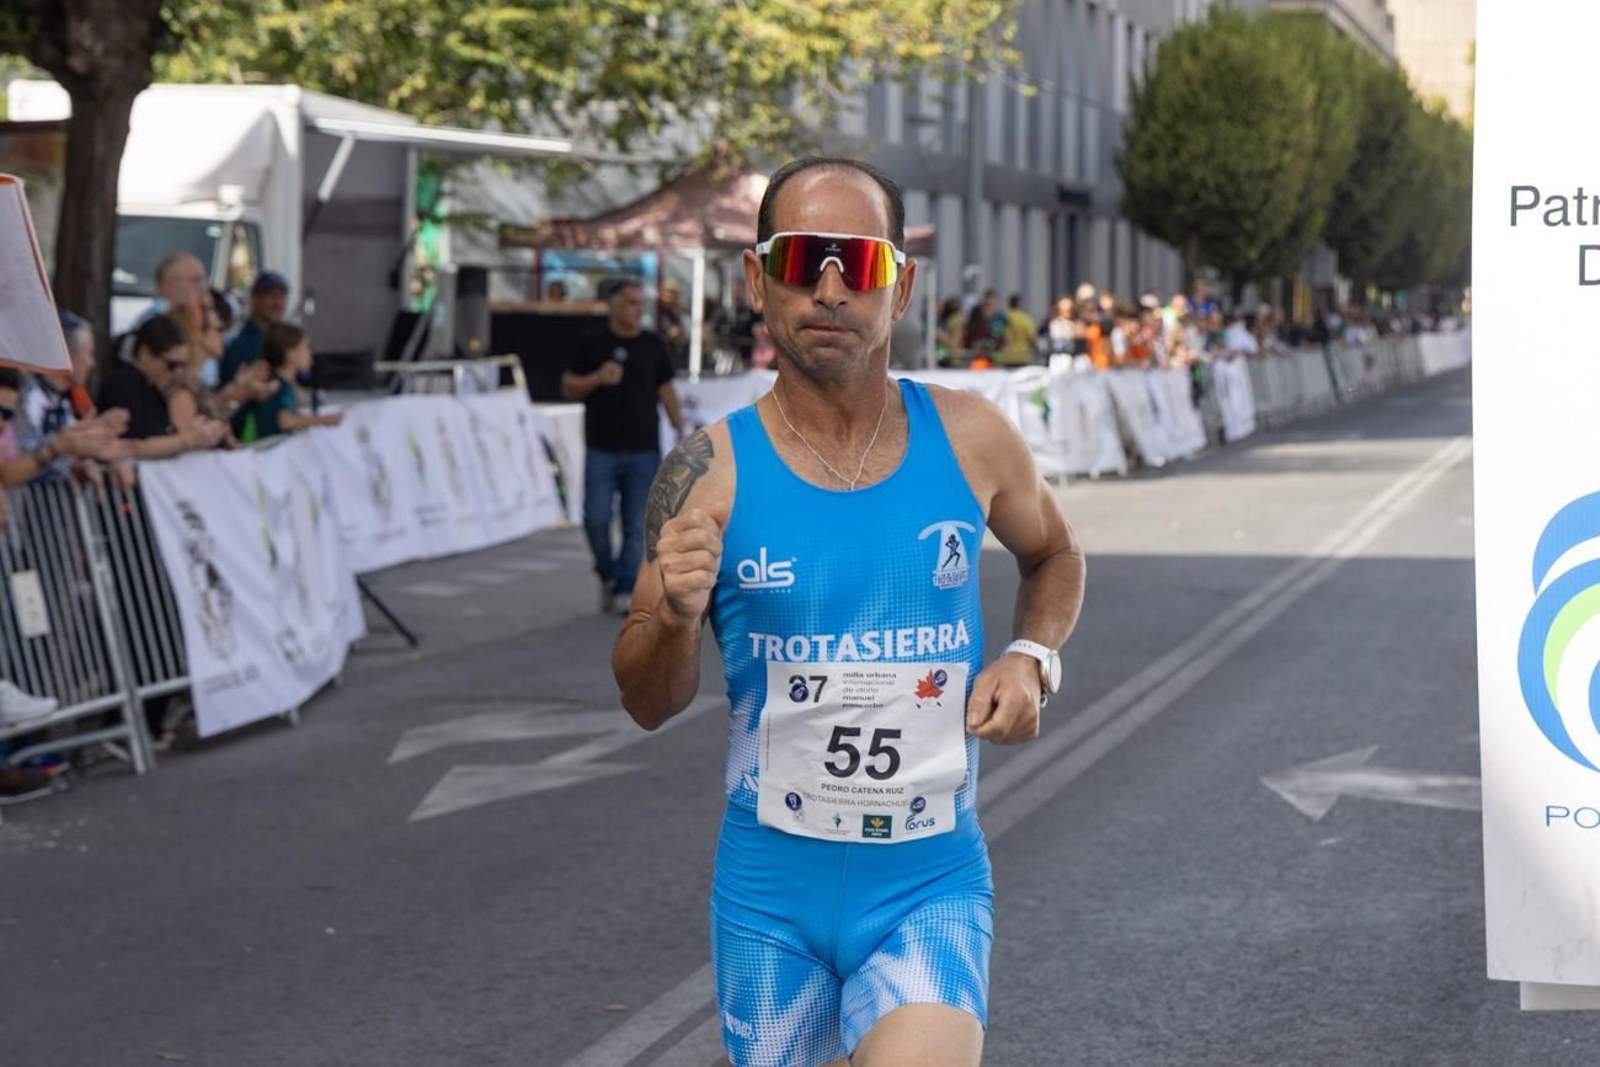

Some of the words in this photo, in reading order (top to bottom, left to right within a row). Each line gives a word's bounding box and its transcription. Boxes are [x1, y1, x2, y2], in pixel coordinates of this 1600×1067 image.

[749, 619, 970, 662] TROTASIERRA
[824, 725, 902, 781] 55
[802, 791, 856, 806] TROTASIERRA
[857, 798, 909, 808] HORNACHUE
[821, 783, 850, 794] PEDRO
[851, 786, 885, 795] CATENA
[885, 787, 905, 795] RUIZ
[1546, 805, 1600, 829] PO
